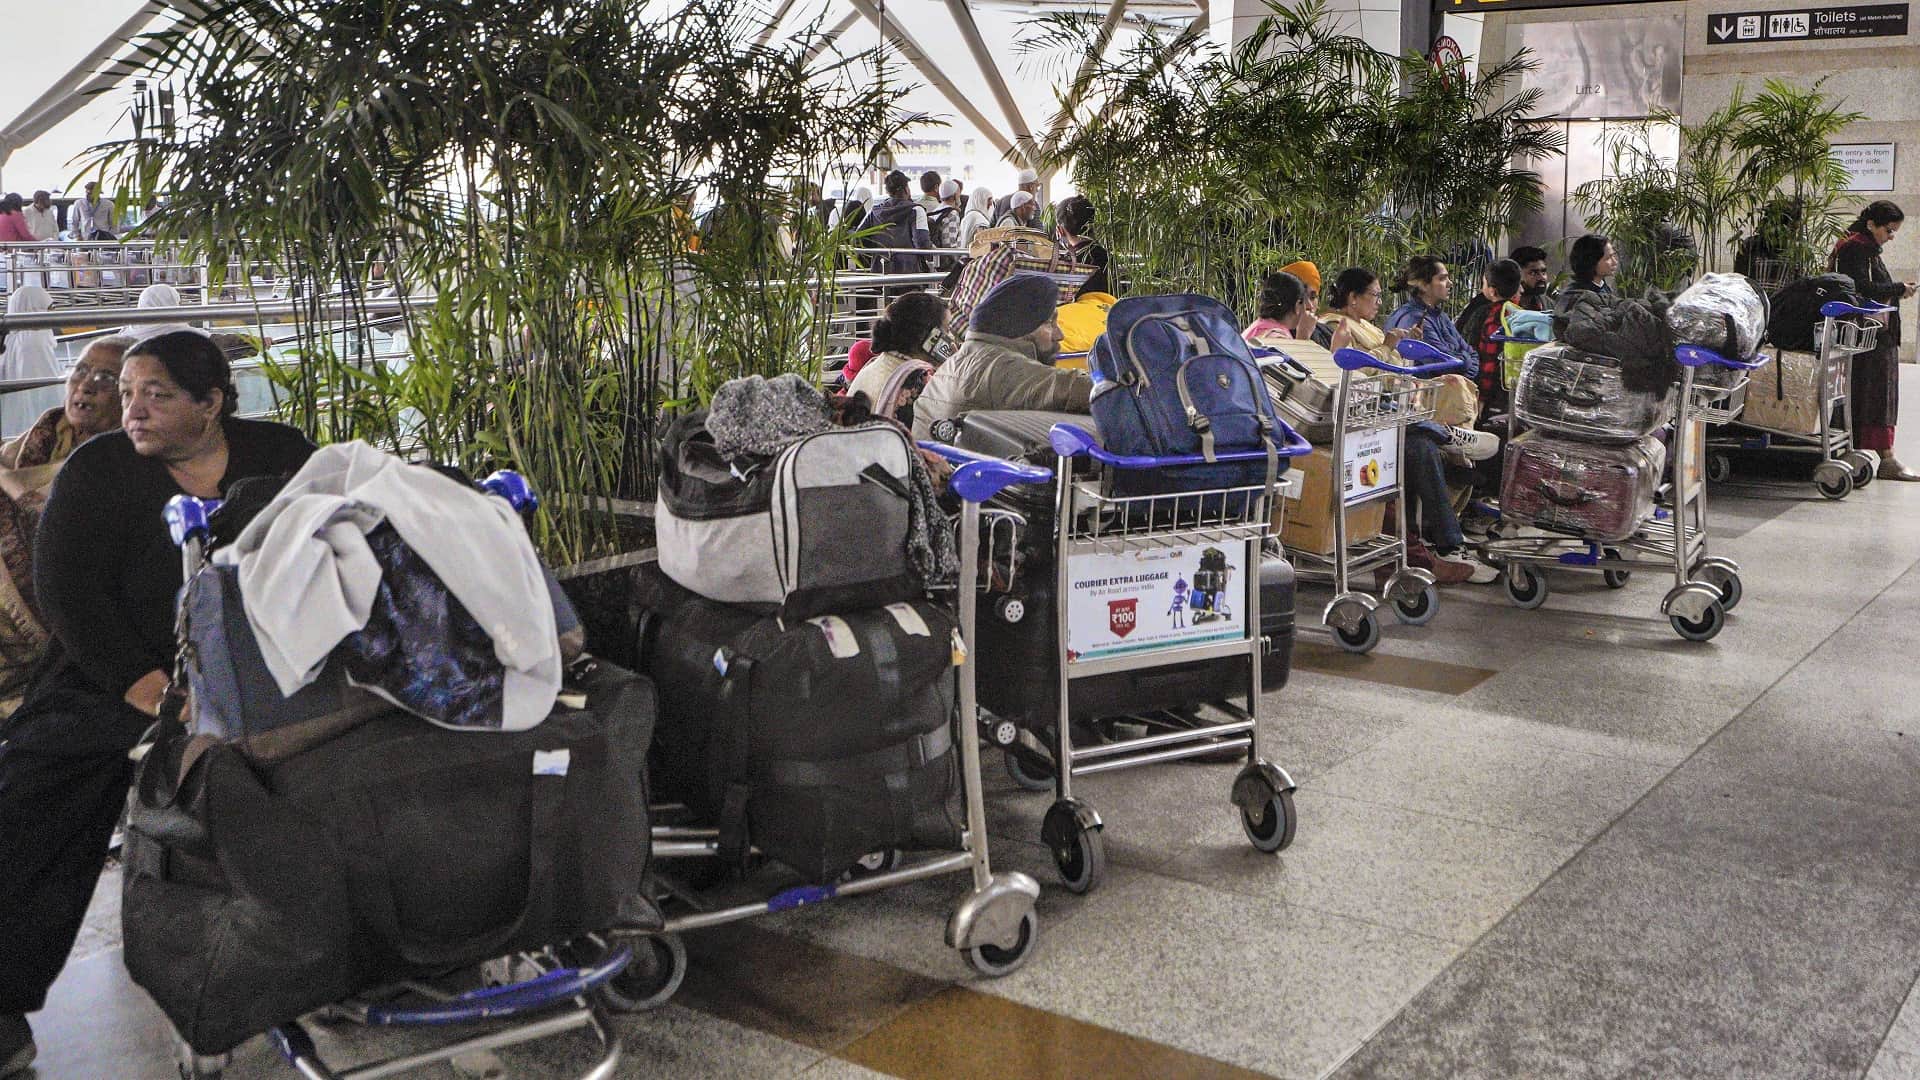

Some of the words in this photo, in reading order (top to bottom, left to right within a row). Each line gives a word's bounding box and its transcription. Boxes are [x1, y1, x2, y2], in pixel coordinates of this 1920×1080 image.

[1814, 11, 1857, 23] Toilets
[1575, 84, 1592, 95] Lift
[1594, 84, 1601, 94] 2
[1074, 578, 1108, 590] COURIER
[1109, 575, 1134, 585] EXTRA
[1135, 571, 1169, 583] LUGGAGE
[1111, 611, 1135, 624] ₹100
